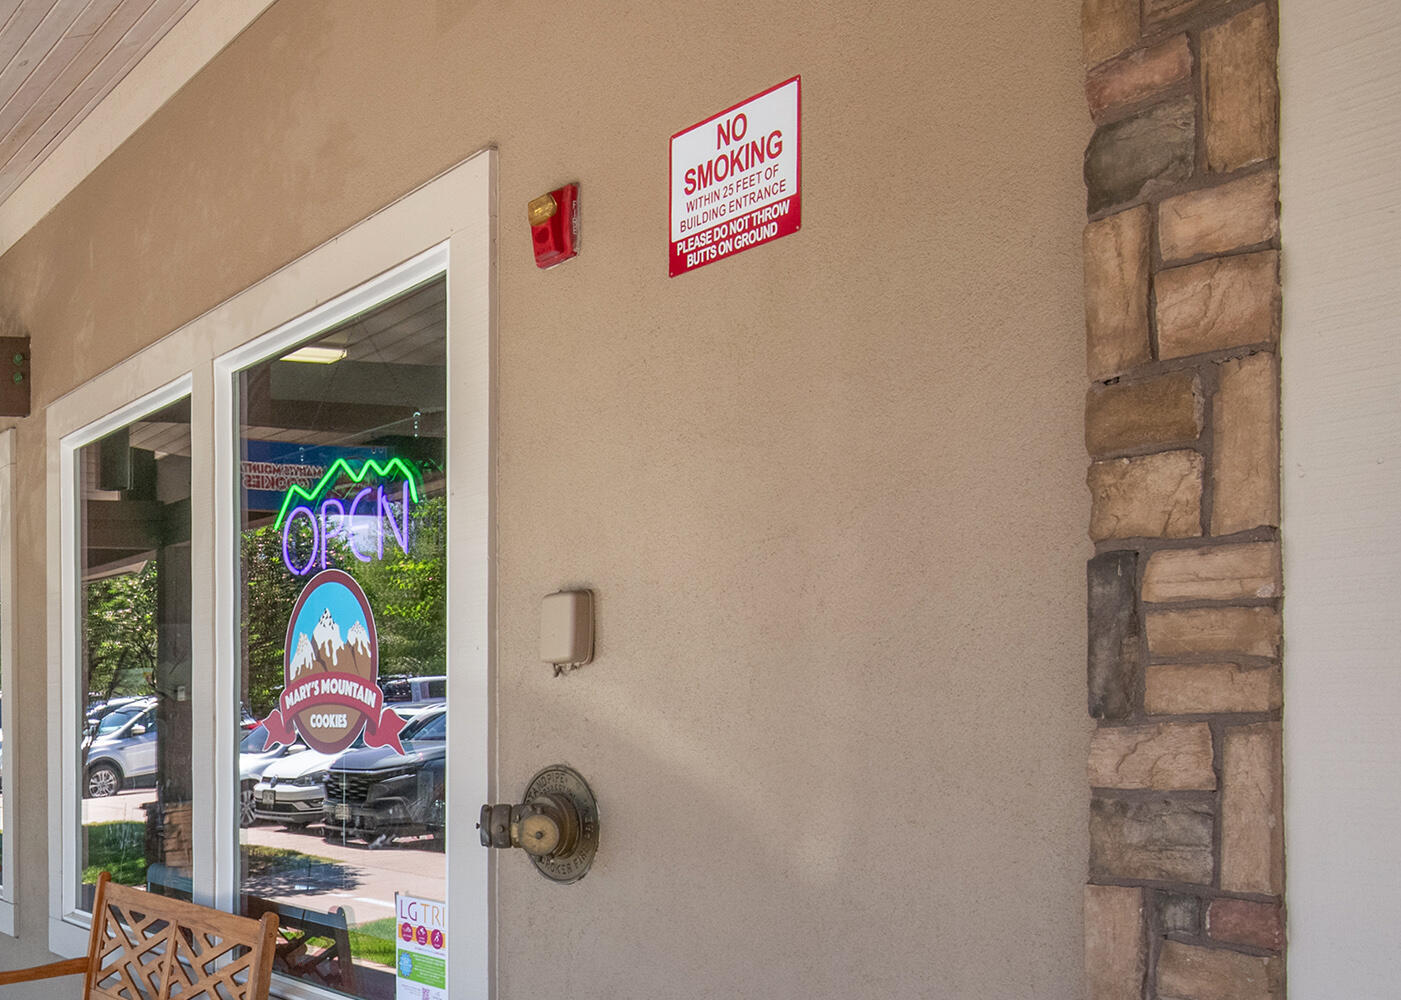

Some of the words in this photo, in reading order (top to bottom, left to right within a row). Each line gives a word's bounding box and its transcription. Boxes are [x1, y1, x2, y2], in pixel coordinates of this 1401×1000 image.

[716, 112, 748, 150] NO
[684, 130, 783, 195] SMOKING
[680, 203, 726, 233] BUILDING
[729, 179, 787, 214] ENTRANCE
[686, 186, 720, 213] WITHIN
[722, 183, 734, 198] 25
[736, 171, 762, 193] FEET
[764, 164, 779, 184] OF
[676, 226, 713, 256] PLEASE
[713, 221, 728, 243] DO
[729, 213, 749, 236] NOT
[751, 200, 790, 224] THROW
[687, 243, 717, 268] BUTTS
[718, 237, 733, 256] ON
[734, 221, 778, 250] GROUND
[283, 480, 410, 576] OPEN
[284, 680, 319, 710] MARY'S
[320, 678, 377, 709] MOUNTAIN
[310, 714, 348, 728] COOKIES
[400, 899, 418, 922] LG
